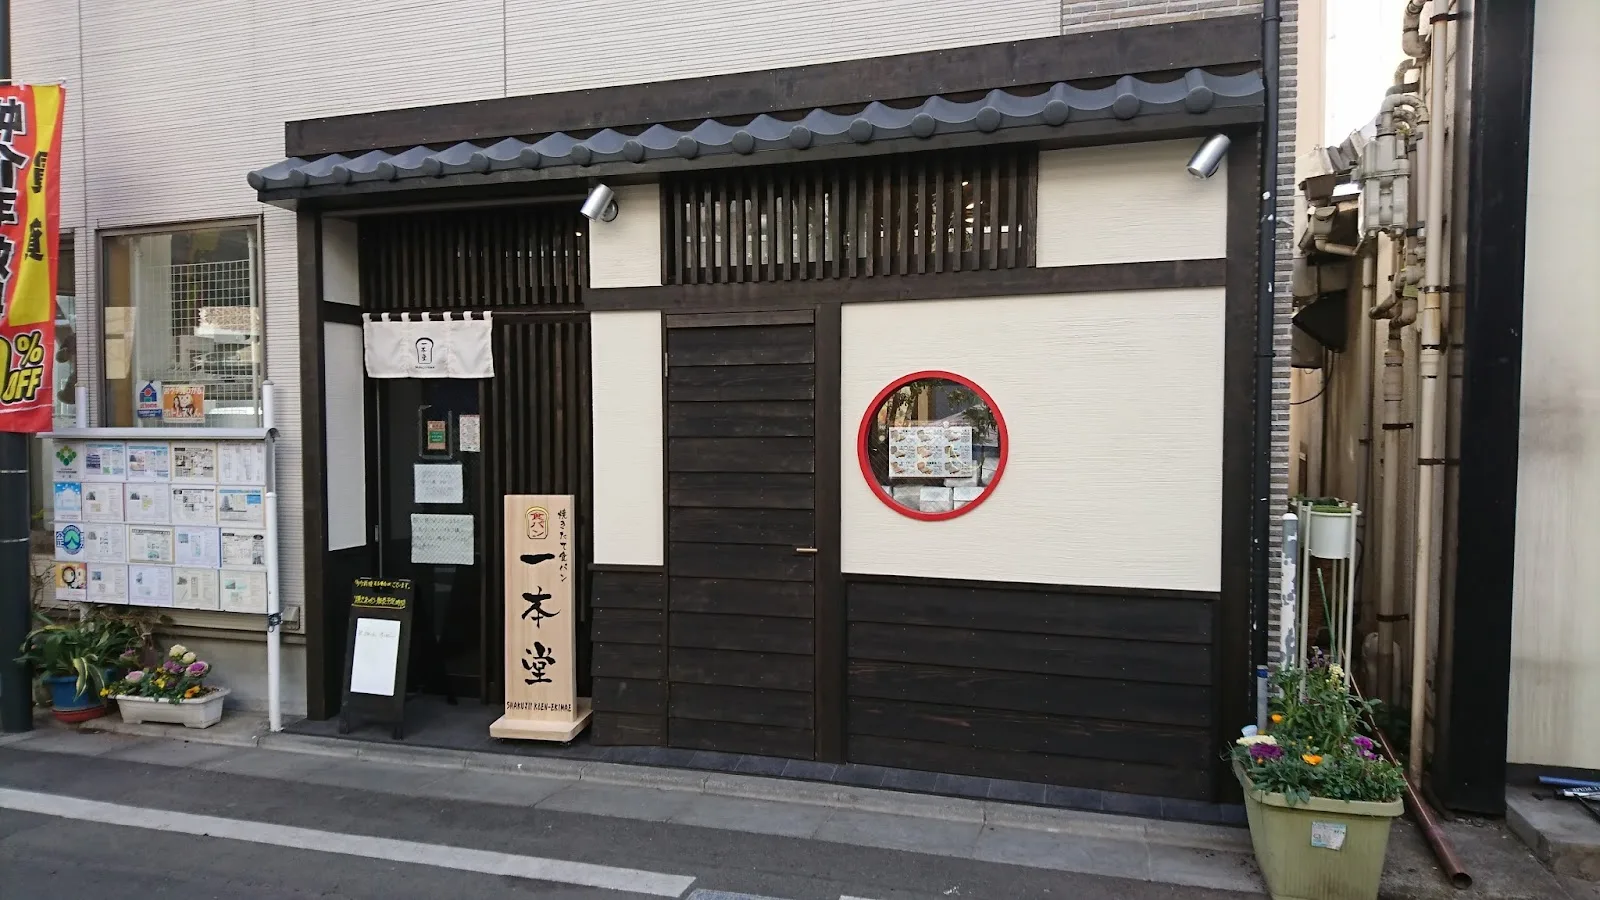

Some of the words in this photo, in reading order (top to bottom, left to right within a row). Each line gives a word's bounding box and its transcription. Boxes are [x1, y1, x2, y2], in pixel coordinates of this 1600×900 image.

[2, 365, 43, 403] OFF
[558, 508, 568, 582] 焼きたて食パン
[520, 553, 561, 685] 一本堂
